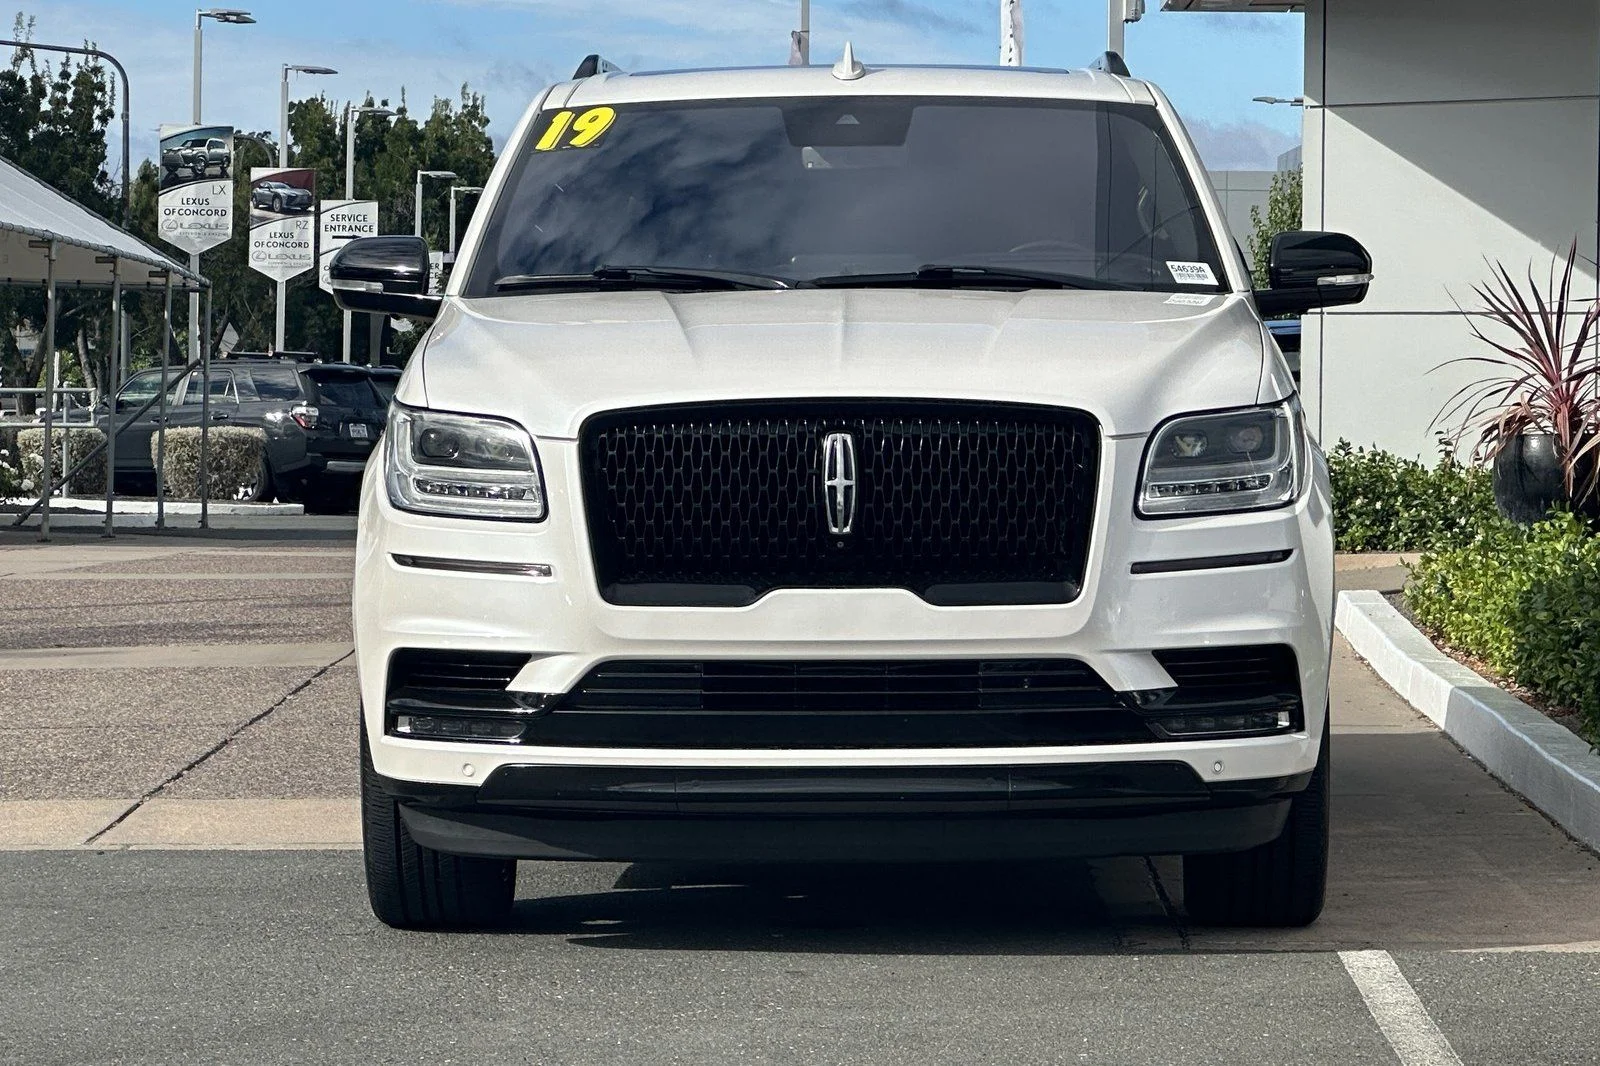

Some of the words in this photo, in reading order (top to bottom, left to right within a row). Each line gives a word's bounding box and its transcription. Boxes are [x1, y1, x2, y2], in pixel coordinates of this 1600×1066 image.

[534, 106, 617, 151] 19
[212, 185, 226, 195] LX
[181, 197, 210, 206] LEXUS
[163, 208, 176, 216] OF
[177, 208, 227, 217] CONCORD
[330, 213, 368, 222] SERVICE
[295, 220, 309, 230] RZ
[324, 224, 374, 233] ENTRANCE
[269, 231, 295, 239] LEXUS
[254, 240, 265, 248] OF
[266, 241, 310, 249] CONCORD
[1170, 264, 1206, 273] 54639A
